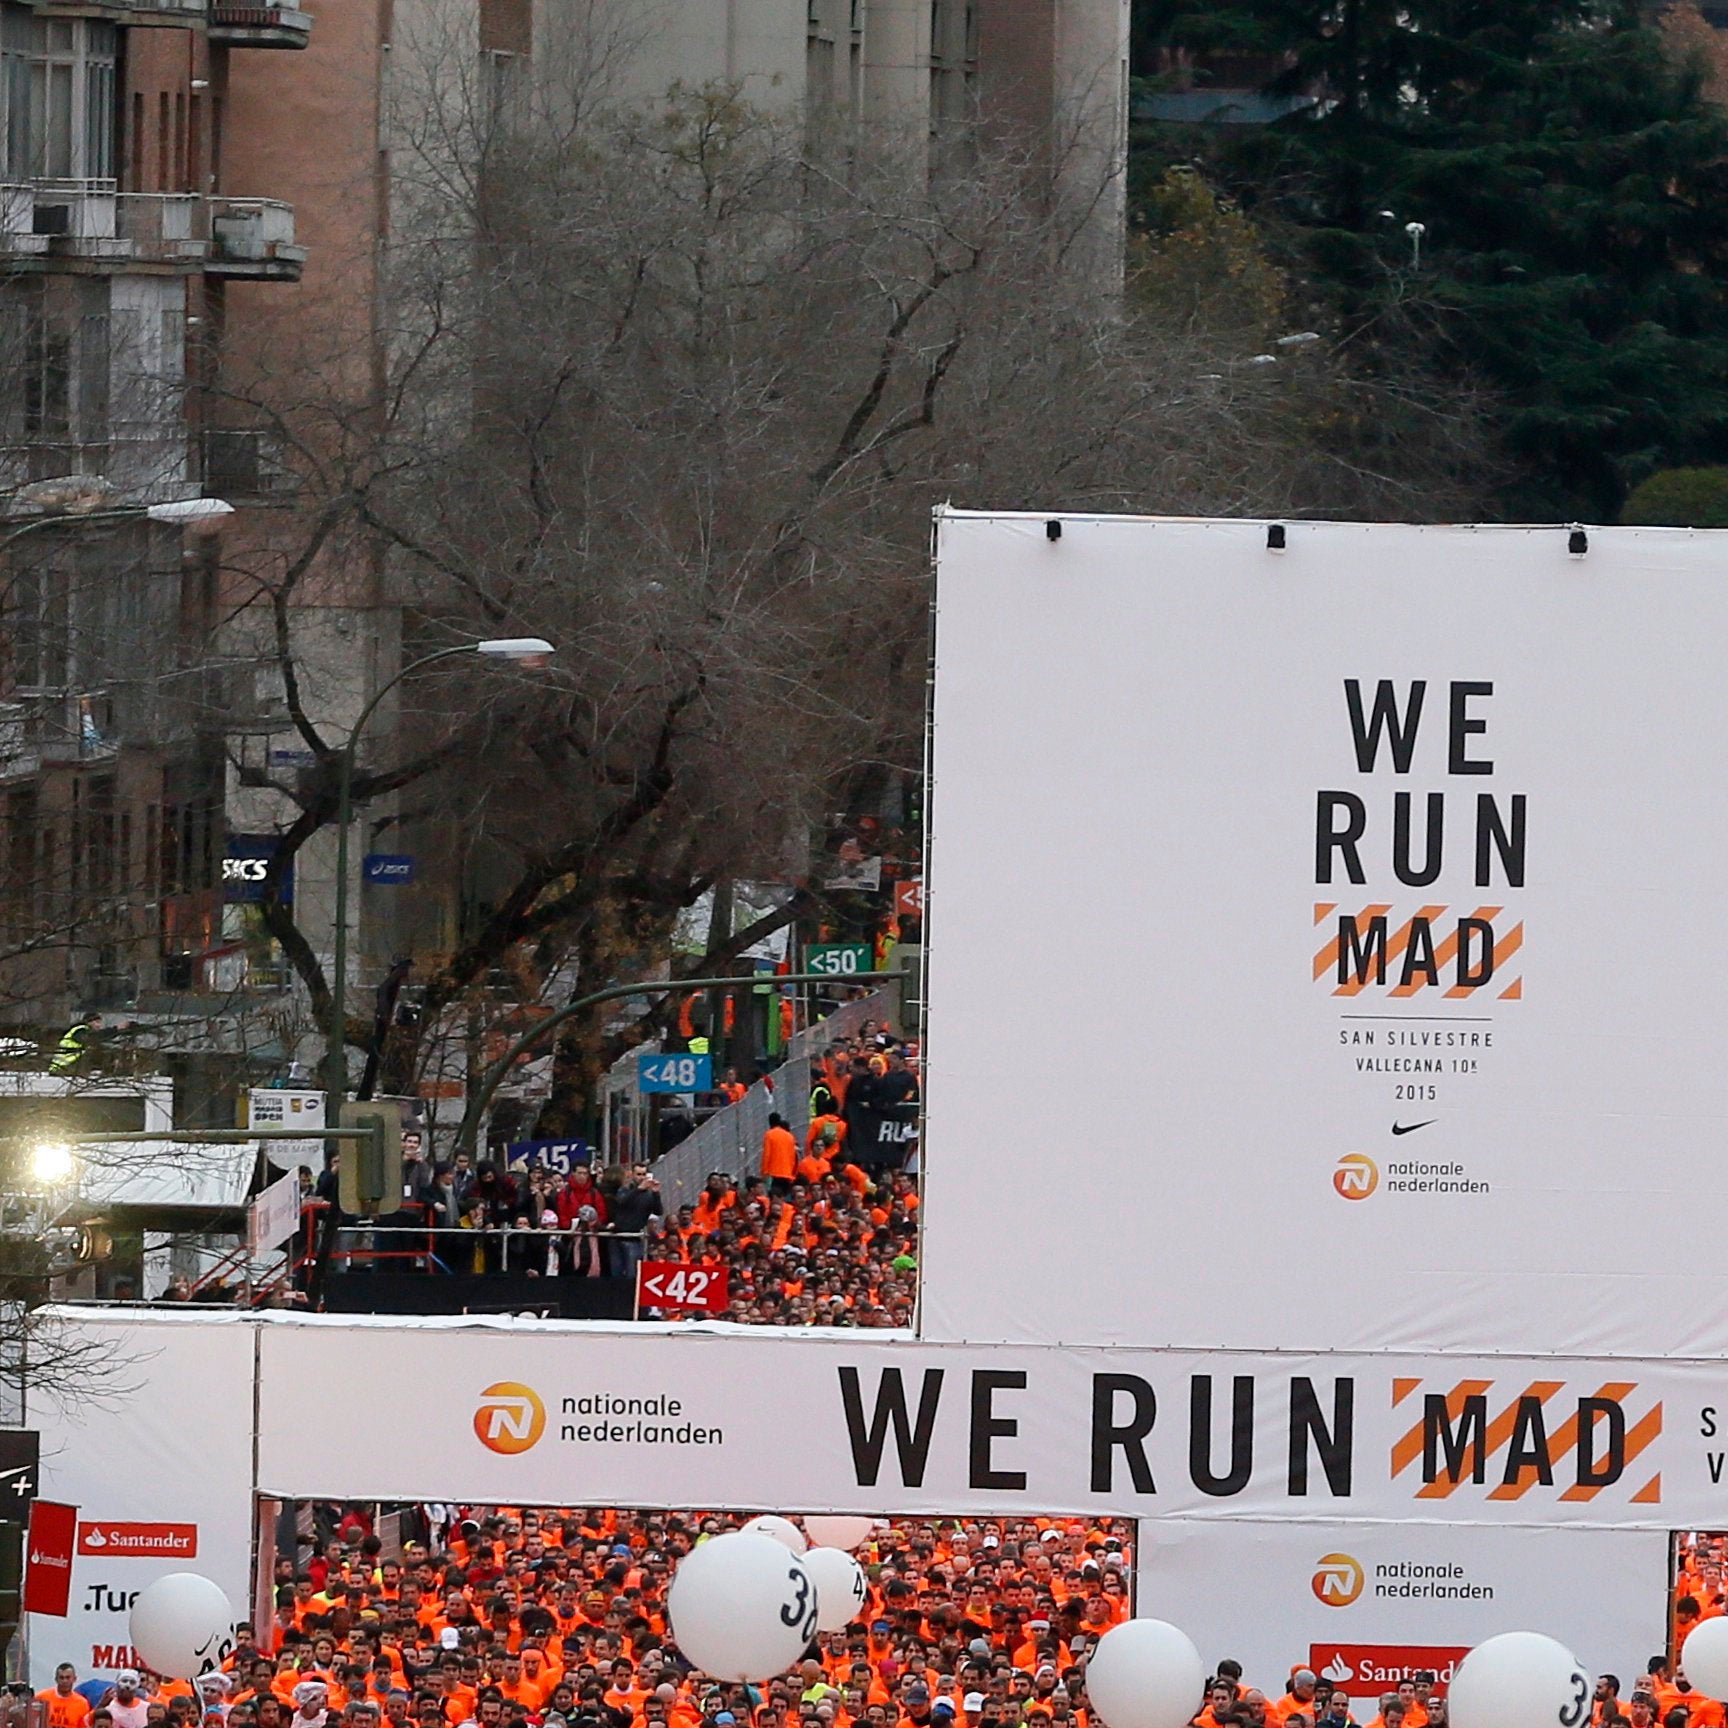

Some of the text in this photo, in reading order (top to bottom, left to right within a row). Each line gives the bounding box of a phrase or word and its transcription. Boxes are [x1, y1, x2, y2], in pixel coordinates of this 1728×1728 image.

[1343, 679, 1494, 775] WE
[1315, 790, 1527, 887] RUN
[1337, 915, 1495, 987] MAD
[1340, 1030, 1493, 1047] SAN SILVESTRE
[1356, 1058, 1443, 1073] VALLECANA
[1395, 1085, 1436, 1100] 2015
[1388, 1161, 1464, 1176] nationale
[1388, 1178, 1489, 1193] nederlanden
[561, 1393, 682, 1418] nationale
[560, 1419, 723, 1446] nederlanden
[838, 1366, 1627, 1496] WE RUN MAD
[109, 1530, 191, 1548] Santander
[1376, 1562, 1464, 1579] nationale
[1376, 1582, 1494, 1600] nederlanden
